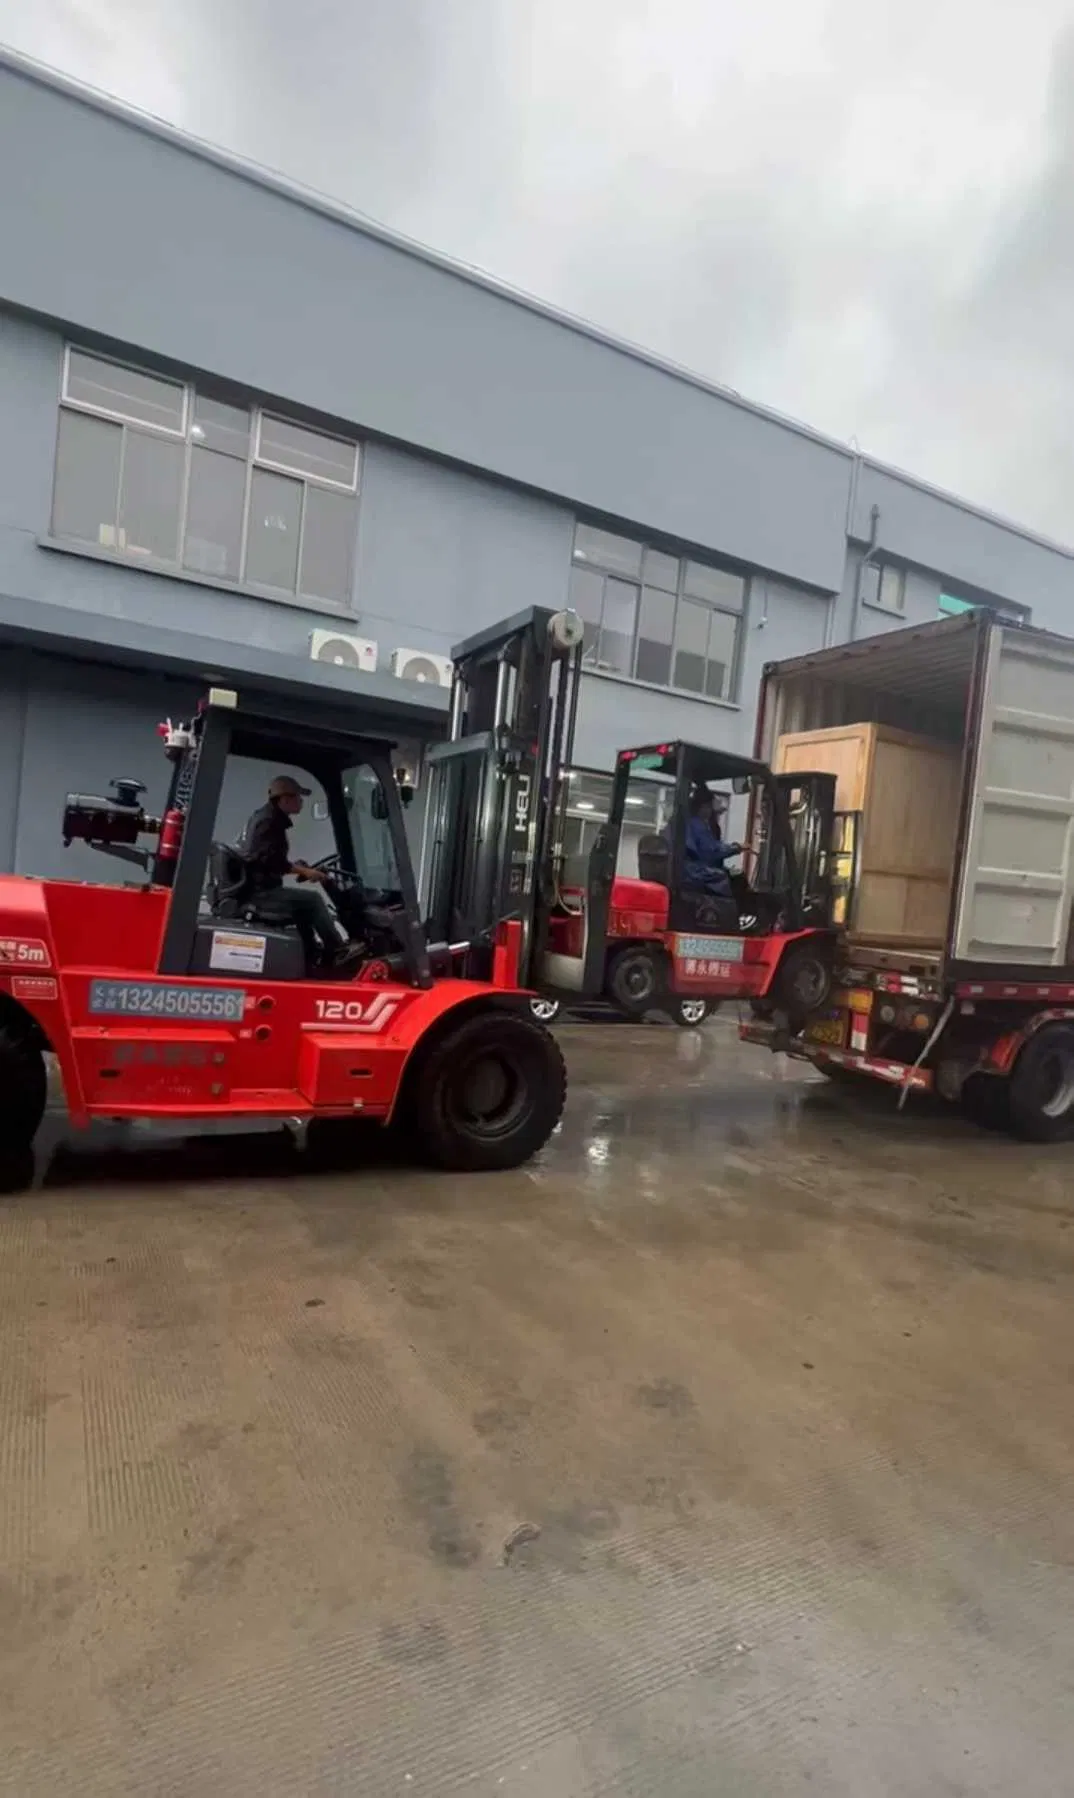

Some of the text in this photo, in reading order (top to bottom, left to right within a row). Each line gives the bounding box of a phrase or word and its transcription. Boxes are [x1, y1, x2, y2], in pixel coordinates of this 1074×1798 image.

[18, 944, 45, 961] 5m
[119, 987, 244, 1020] 13245055561
[316, 1000, 363, 1020] 120
